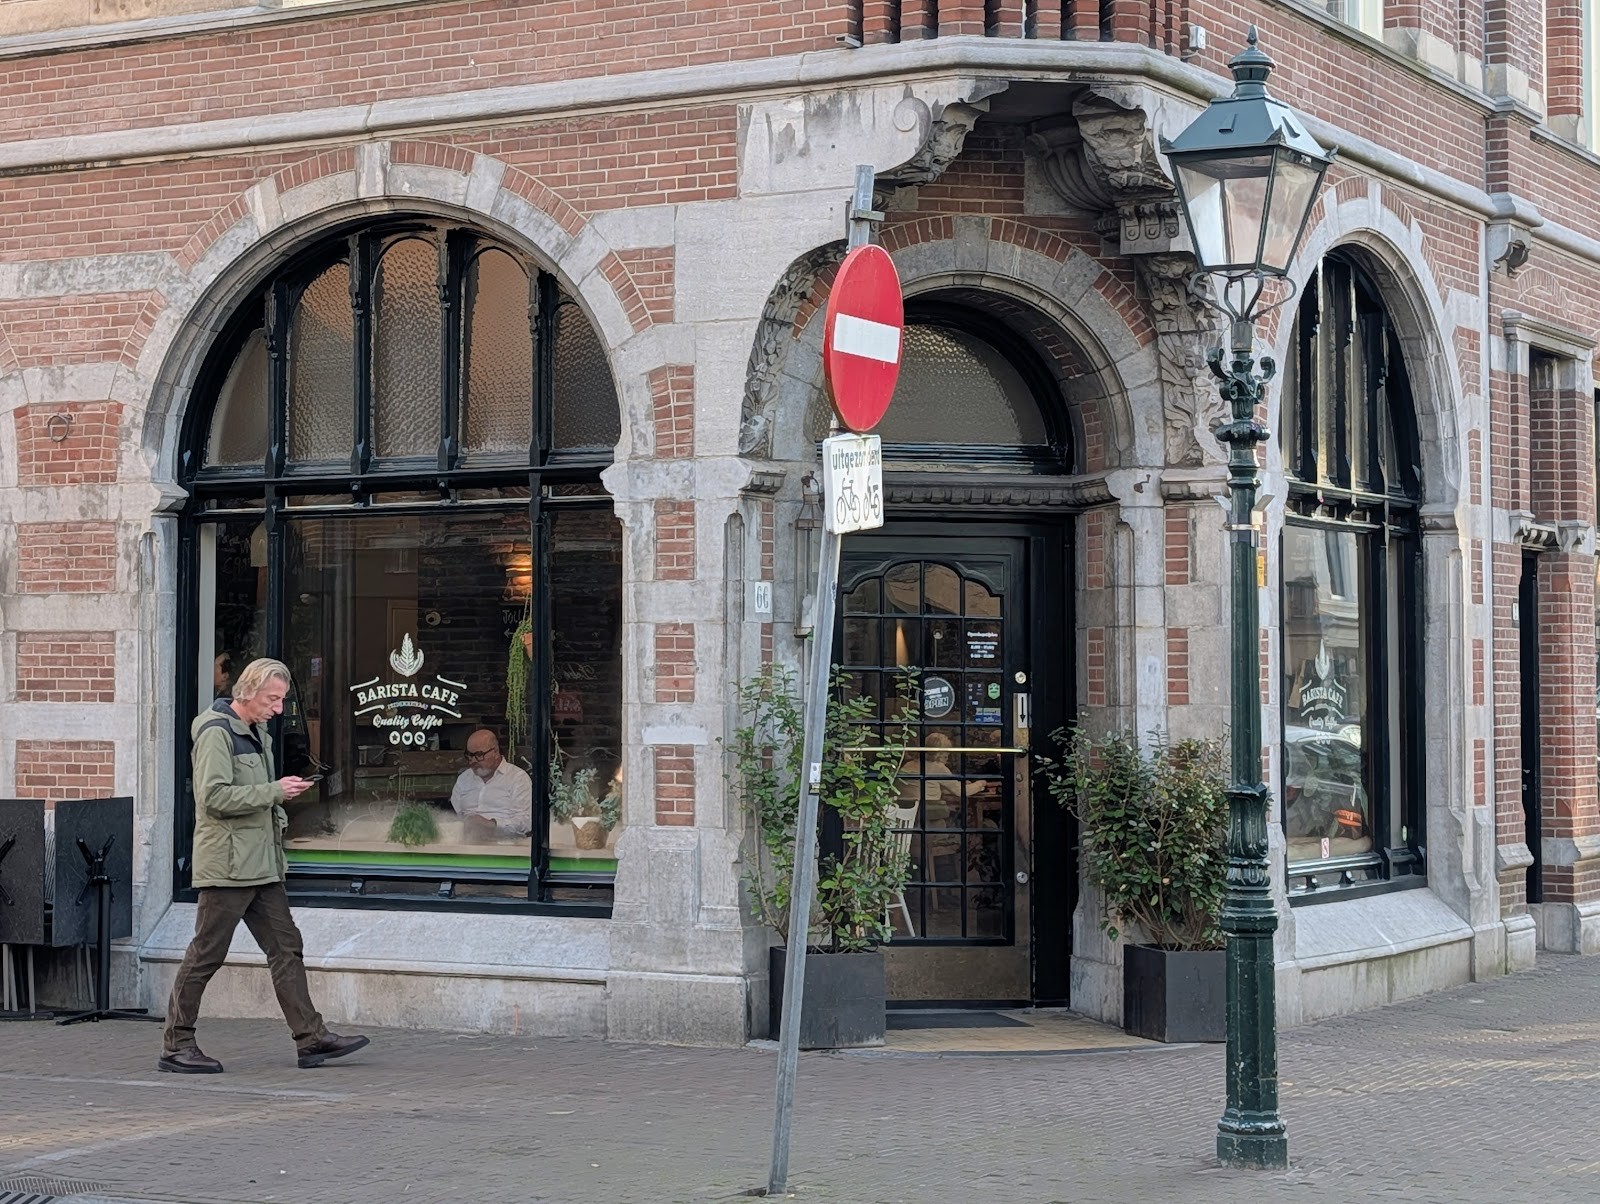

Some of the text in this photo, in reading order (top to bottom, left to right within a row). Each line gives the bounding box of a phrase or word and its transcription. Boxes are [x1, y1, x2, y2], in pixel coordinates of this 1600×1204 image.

[356, 683, 418, 706] BARISTA
[421, 684, 459, 707] CAFE
[372, 713, 443, 730] Quality Coffee
